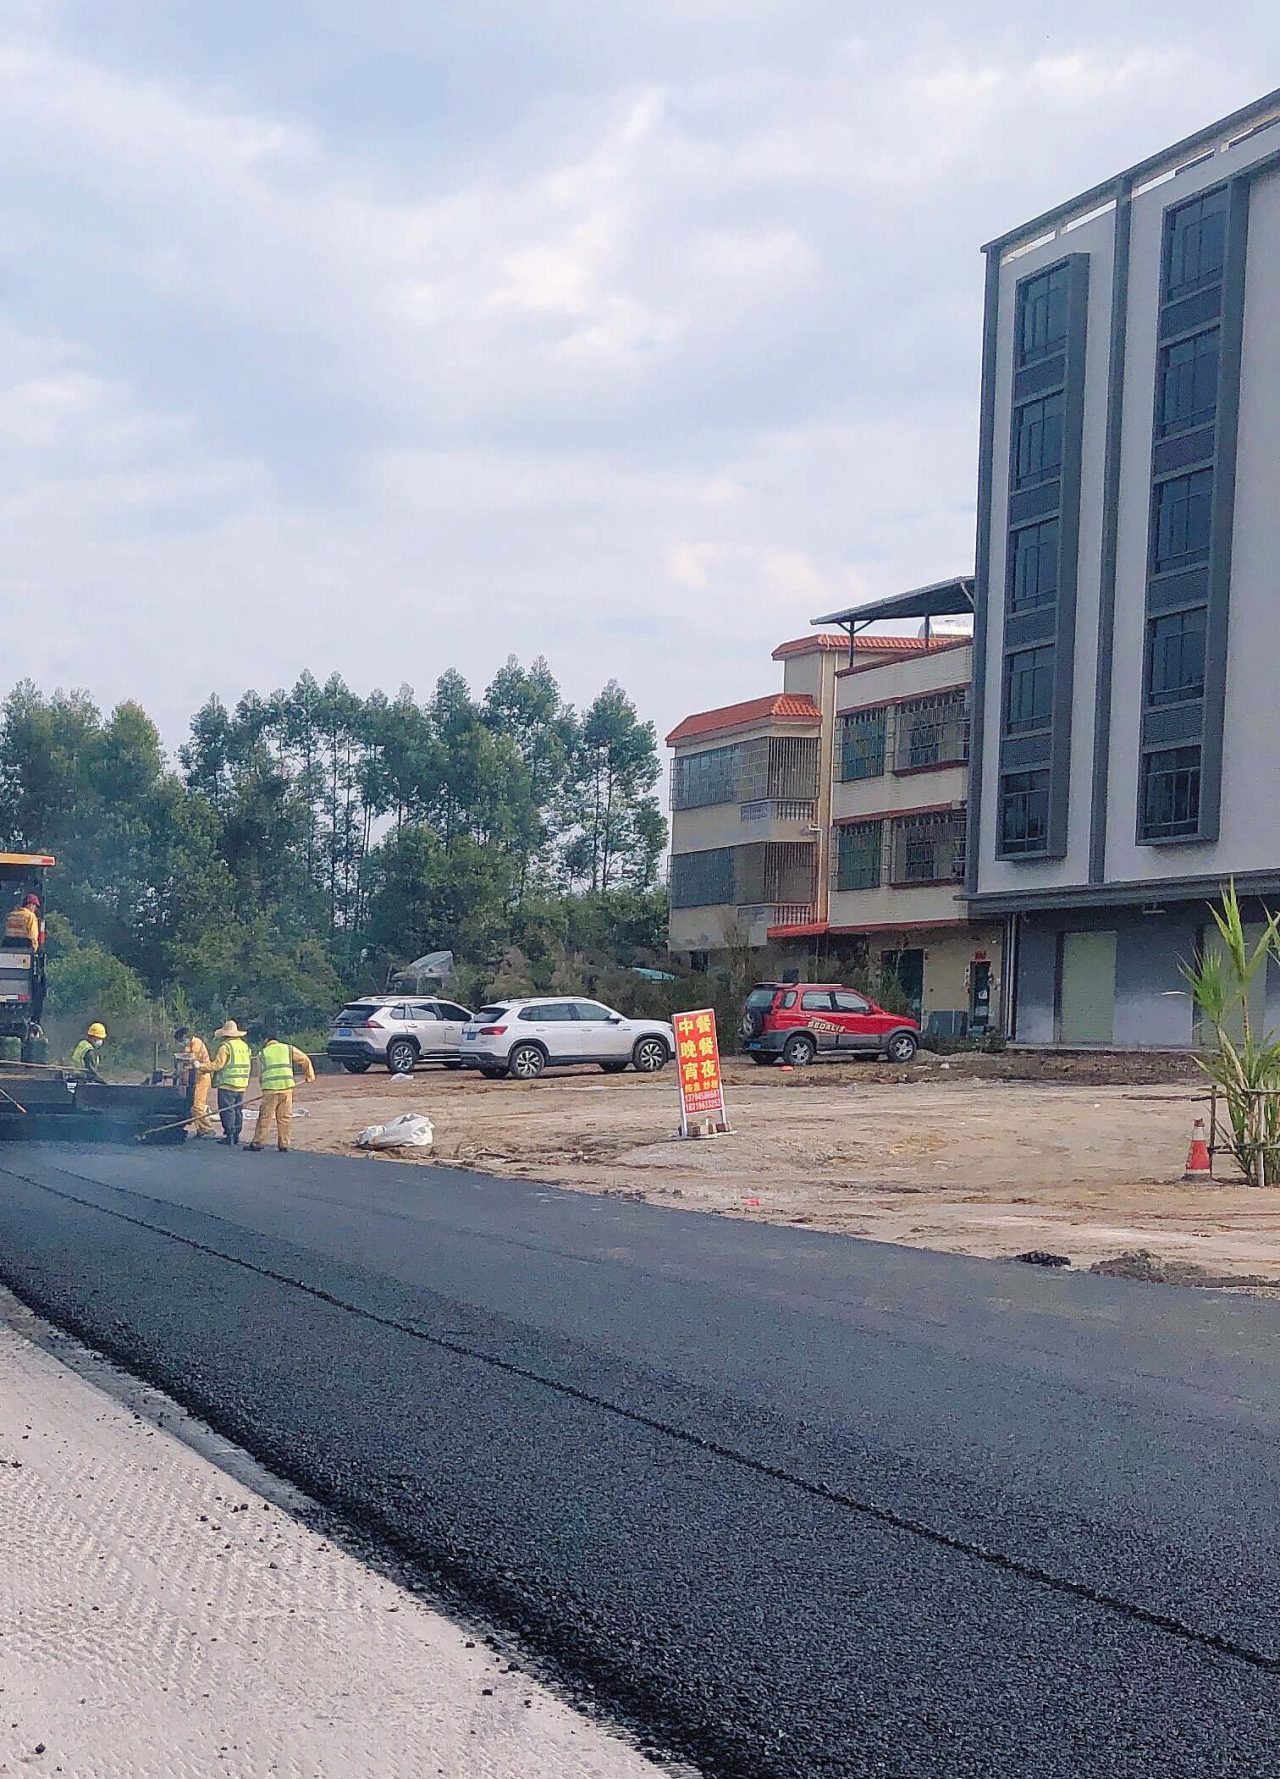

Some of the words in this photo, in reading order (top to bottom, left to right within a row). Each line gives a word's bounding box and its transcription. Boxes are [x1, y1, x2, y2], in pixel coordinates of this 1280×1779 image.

[679, 1014, 711, 1036] 中餐
[680, 1036, 714, 1059] 晚餐
[683, 1059, 717, 1080] 宵夜
